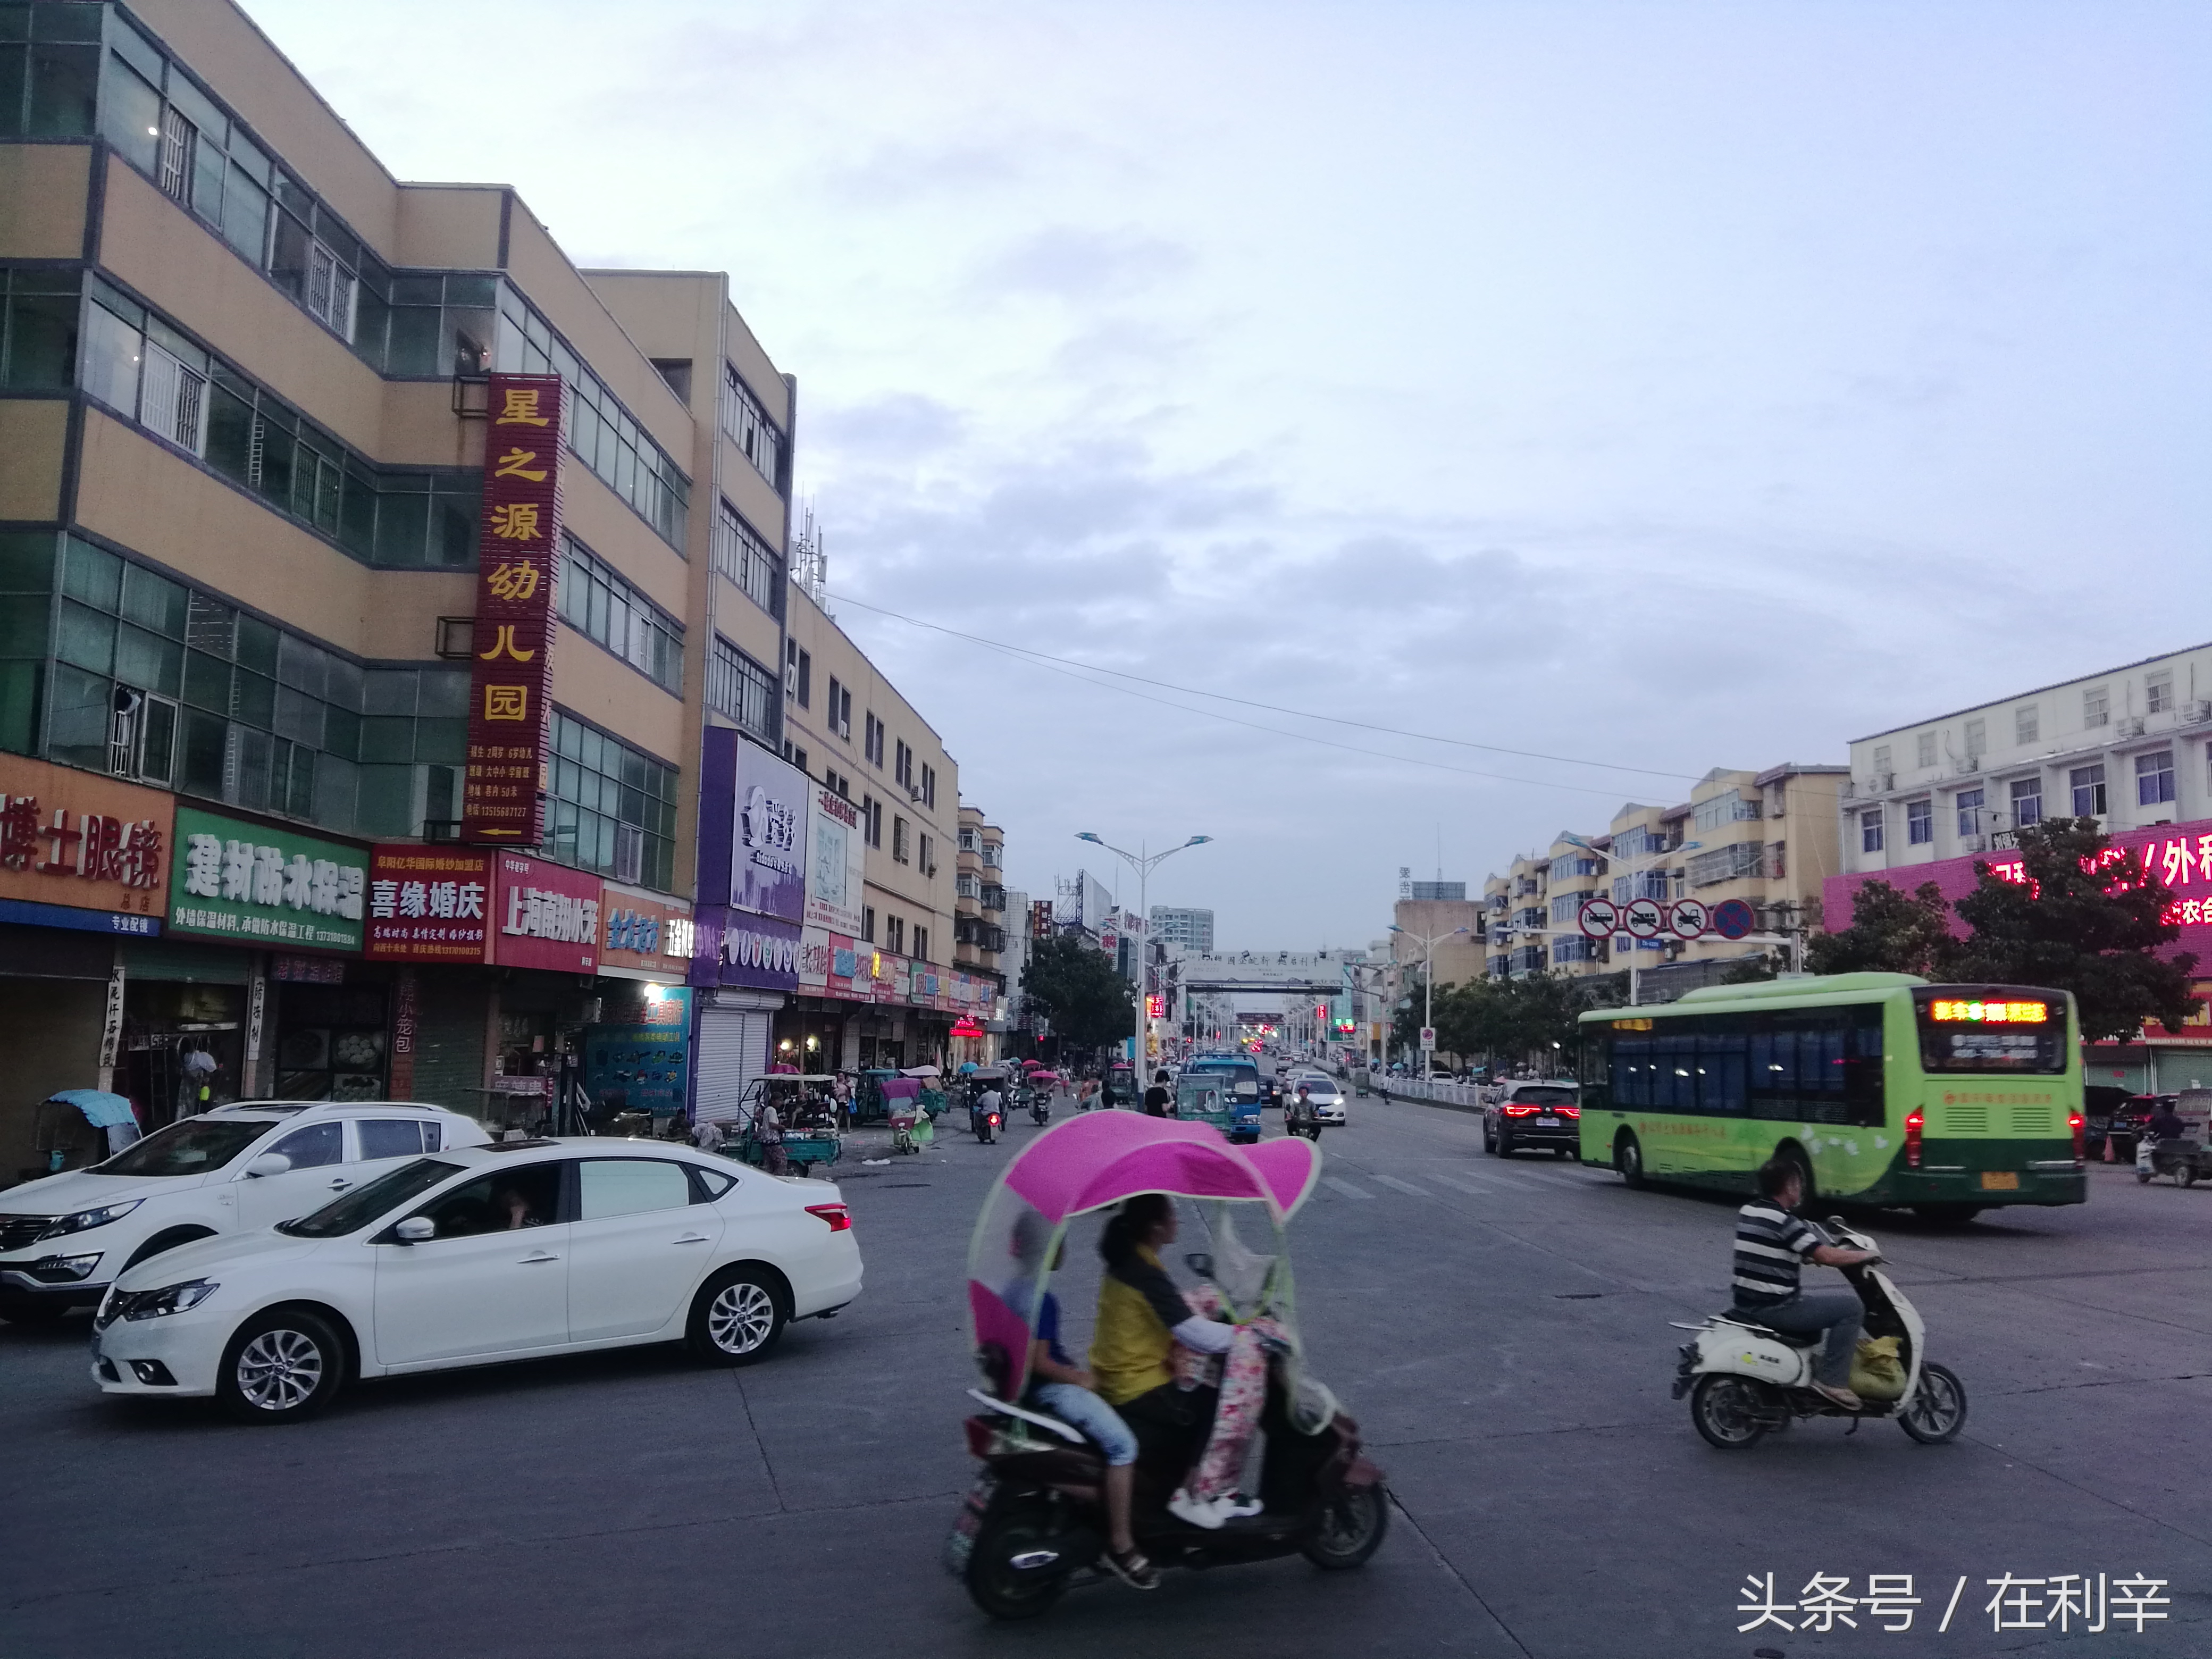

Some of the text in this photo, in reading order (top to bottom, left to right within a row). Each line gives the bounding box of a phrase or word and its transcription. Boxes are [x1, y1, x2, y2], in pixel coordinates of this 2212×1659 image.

[480, 389, 550, 721] 星之源幼儿园
[471, 745, 532, 759] 招生 2周岁 6岁幼儿
[486, 766, 505, 778] 大中小
[501, 786, 517, 798] 50米
[466, 804, 526, 817] 电话 13515687127
[0, 794, 162, 889] 博士眼镜
[377, 855, 484, 872] 阜阳亿华国际婚纱加盟店
[186, 834, 364, 920] 建材防水保温
[371, 879, 484, 920] 喜缘婚庆
[502, 885, 598, 944] 上海南翔小笼
[112, 915, 148, 933] 专业配镜
[374, 925, 408, 939] 高端时尚
[449, 928, 483, 941] 婚纱摄影
[665, 918, 694, 959] 五金机电
